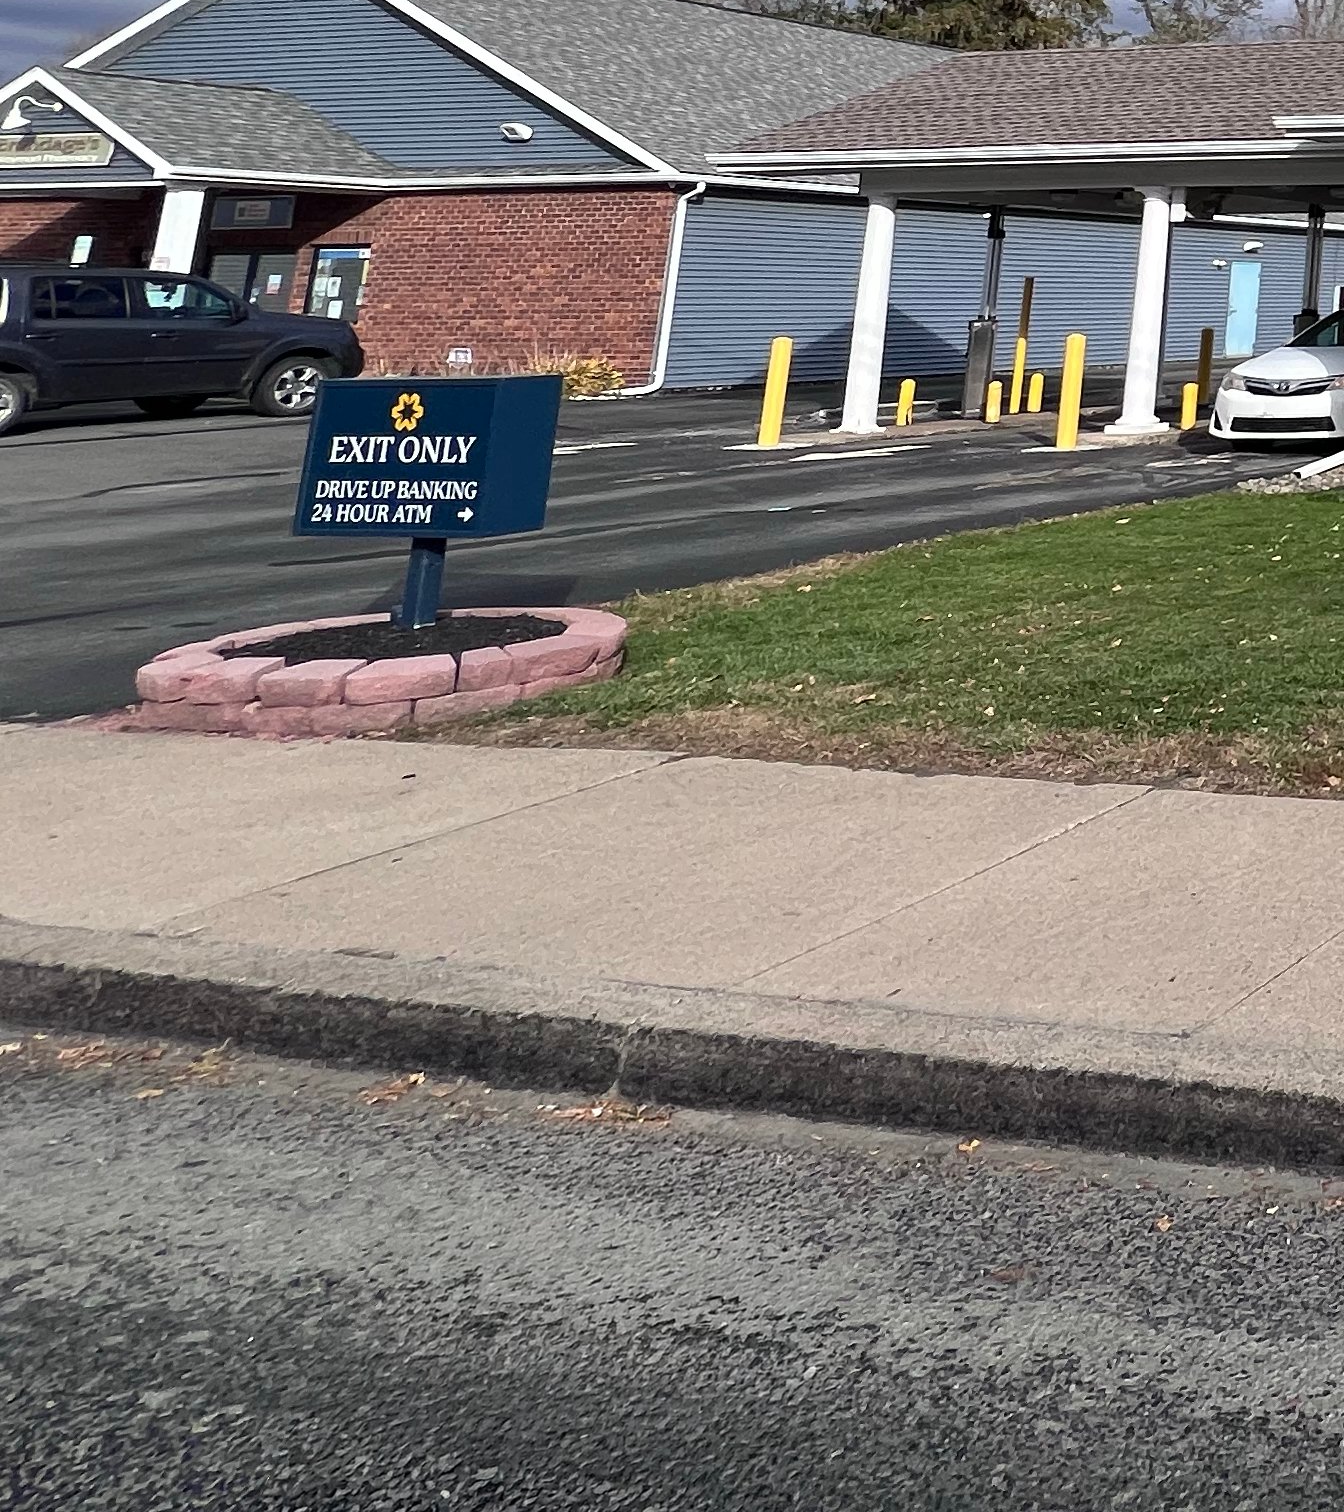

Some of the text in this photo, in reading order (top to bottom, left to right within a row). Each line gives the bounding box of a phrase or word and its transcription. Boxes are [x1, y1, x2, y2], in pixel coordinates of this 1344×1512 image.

[328, 436, 477, 464] EXIT ONLY
[315, 480, 478, 500] DRIVE UP BANKING
[310, 503, 433, 524] 24 HOUR ATM
